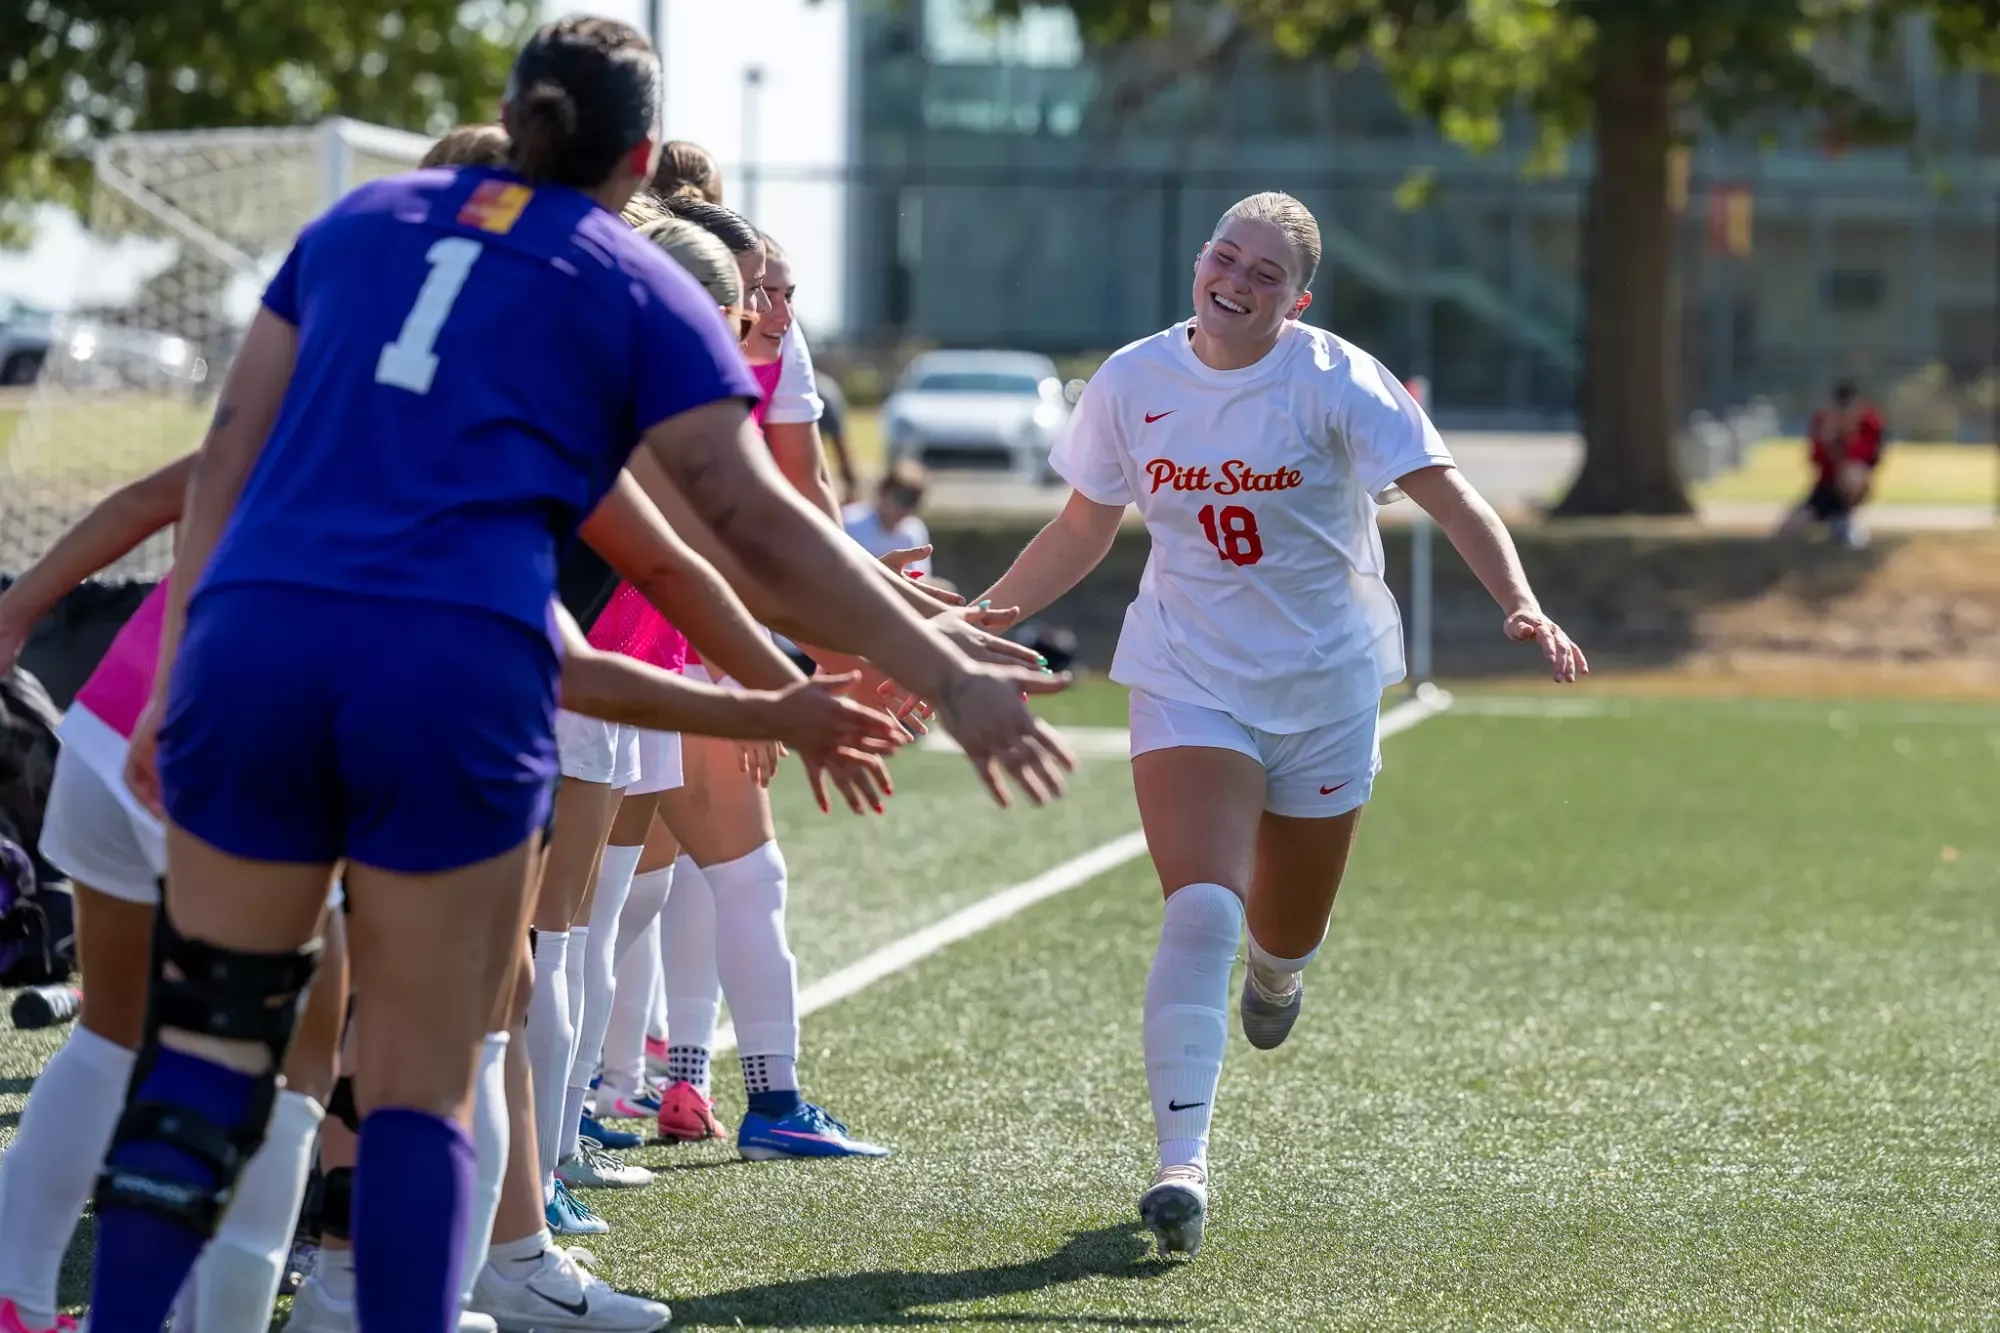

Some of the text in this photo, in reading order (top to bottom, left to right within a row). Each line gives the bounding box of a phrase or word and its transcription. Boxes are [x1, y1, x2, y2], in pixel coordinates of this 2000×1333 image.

[375, 236, 484, 396] 1
[1145, 458, 1304, 496] Pitt State
[1197, 504, 1264, 567] 18
